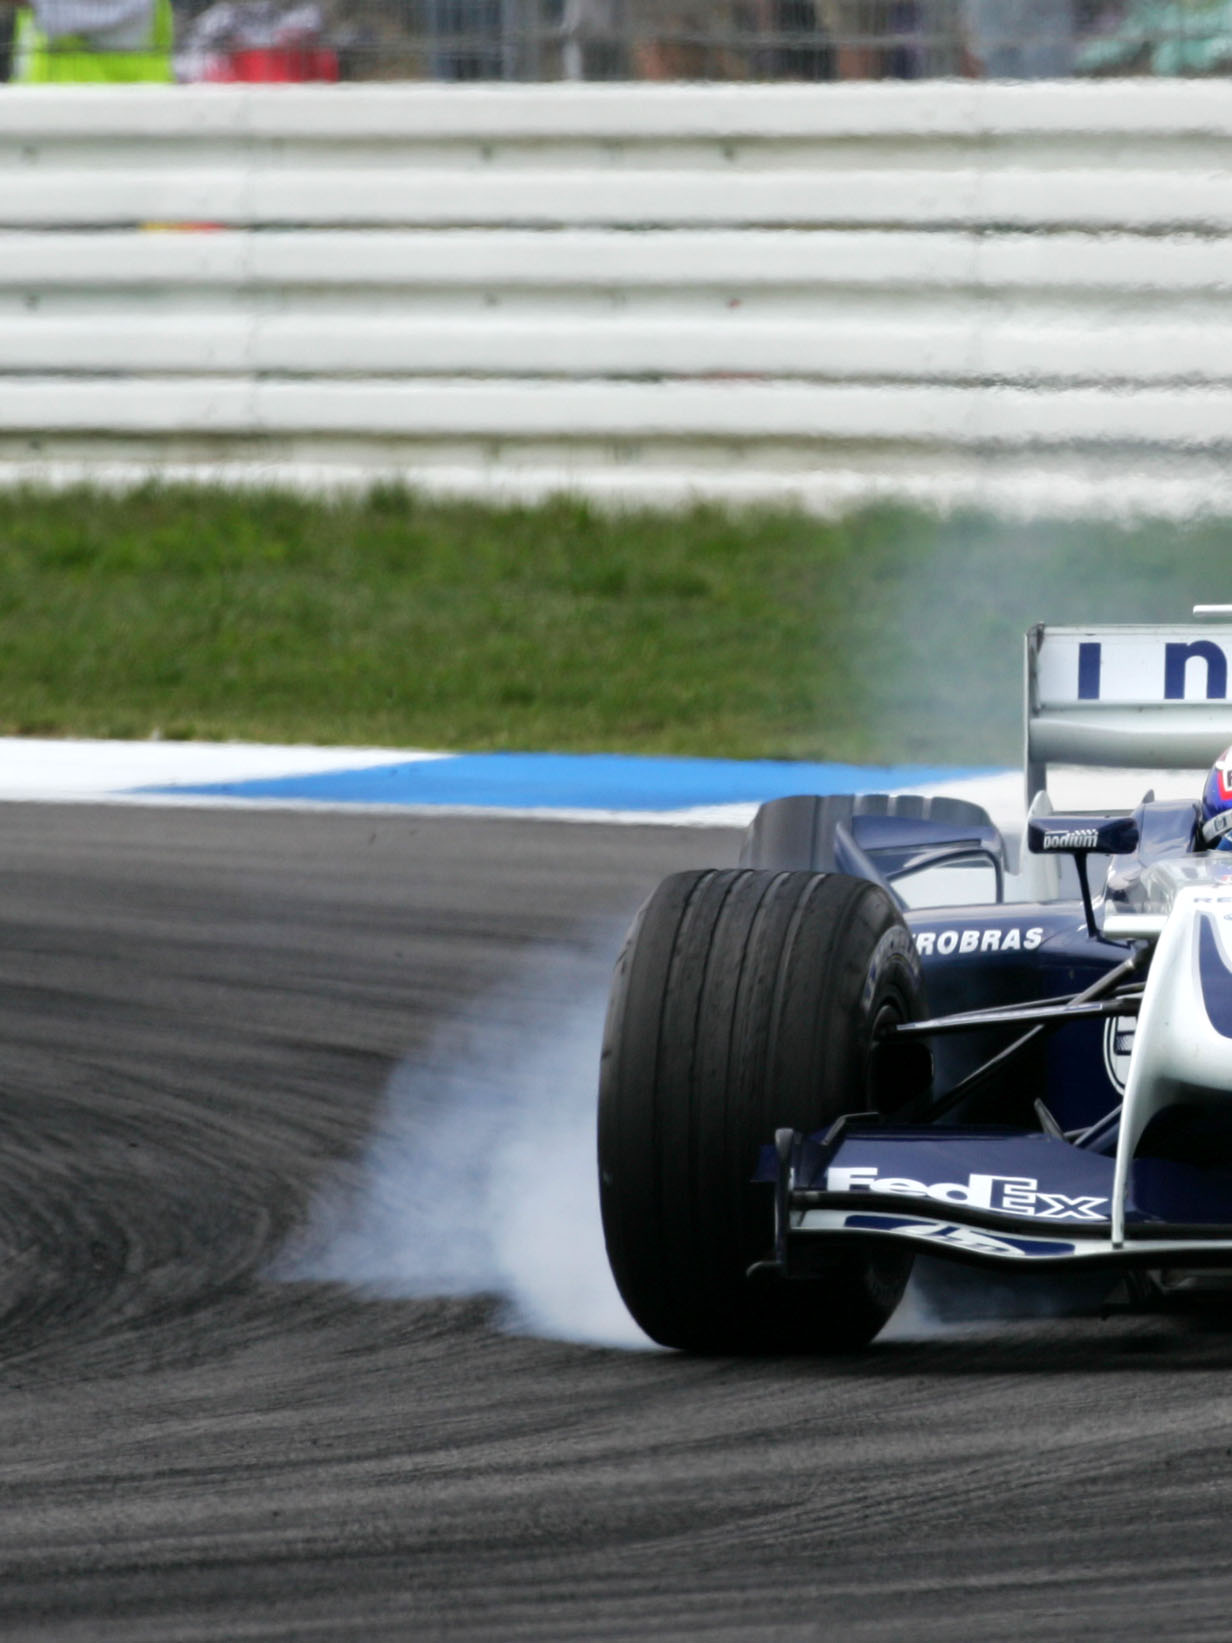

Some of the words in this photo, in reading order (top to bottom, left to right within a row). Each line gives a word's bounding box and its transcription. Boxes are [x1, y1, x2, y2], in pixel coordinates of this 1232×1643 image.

[1043, 829, 1099, 849] podium
[911, 927, 1044, 955] ROBRAS
[827, 1167, 1109, 1220] FedEx
